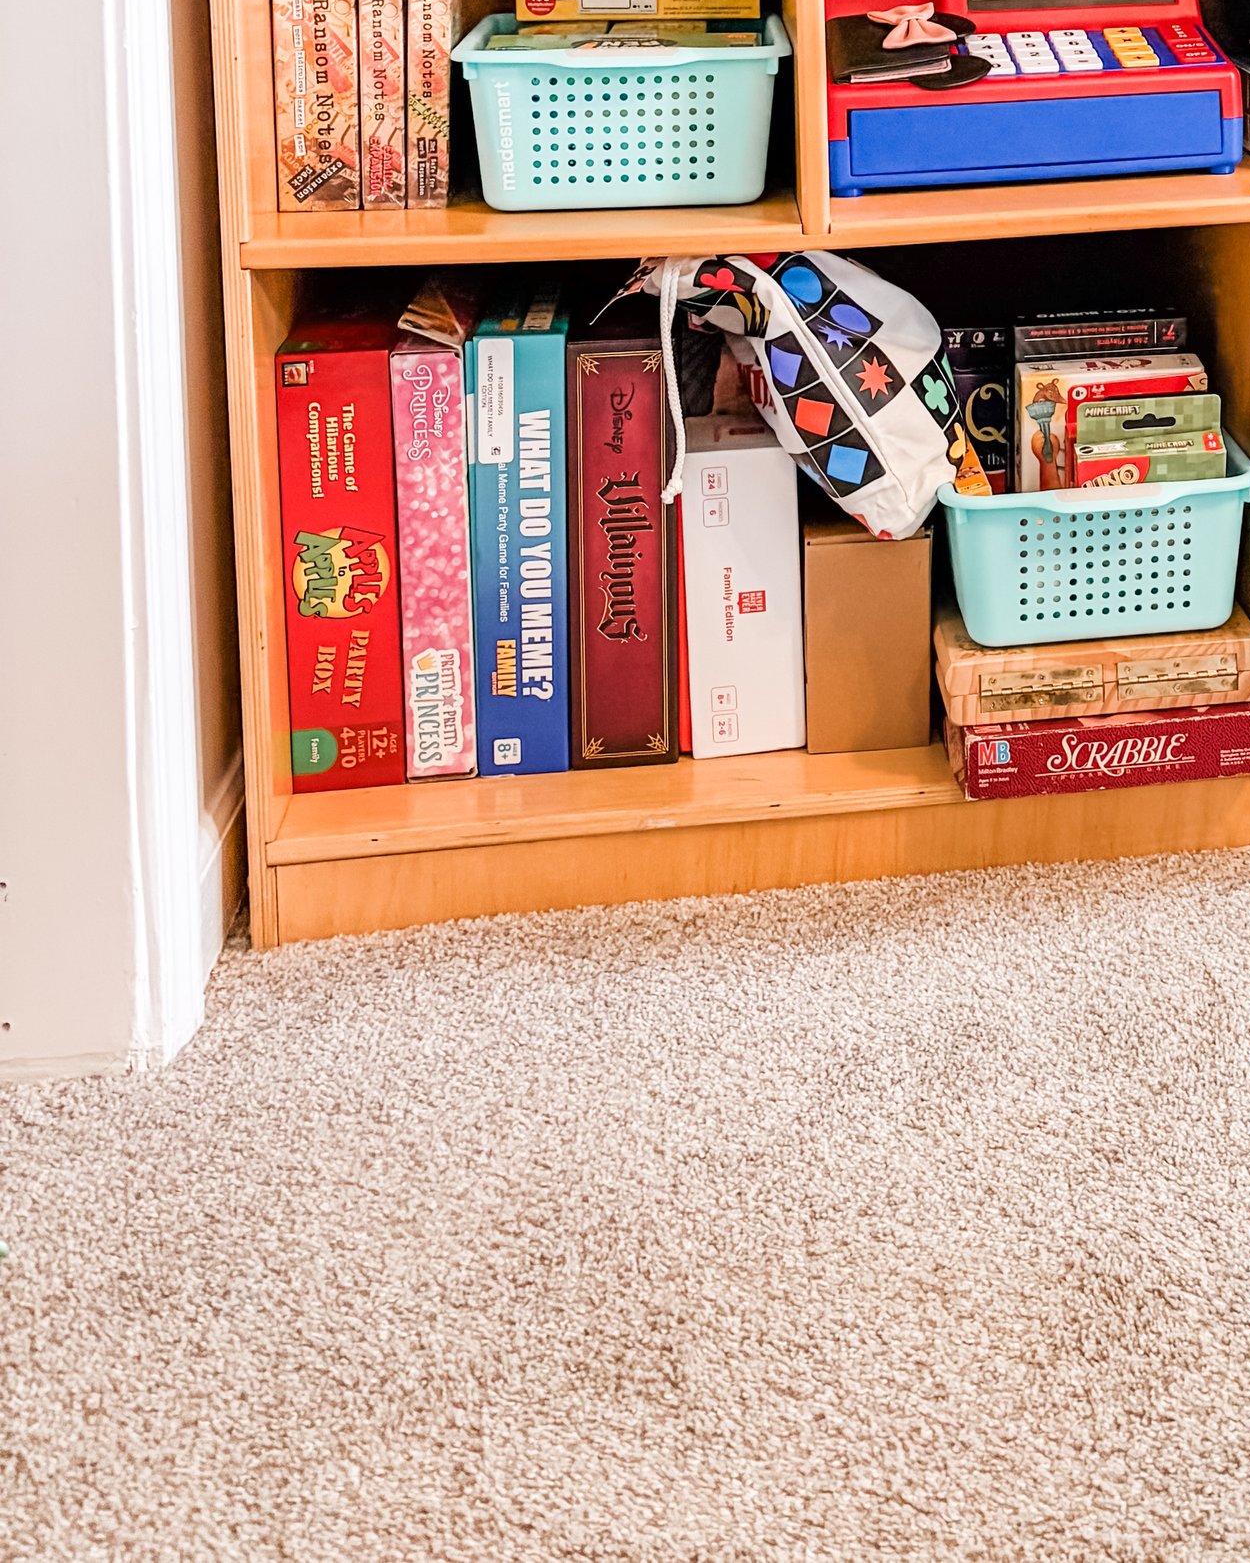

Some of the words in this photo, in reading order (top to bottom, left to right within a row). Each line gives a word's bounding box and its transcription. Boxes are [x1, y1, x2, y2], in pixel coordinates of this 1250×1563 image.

[297, 51, 305, 94] ridiculous
[423, 49, 436, 99] Notes
[374, 68, 387, 122] Notes
[315, 93, 335, 165] Notes
[495, 81, 516, 191] madesmart
[341, 402, 355, 430] The
[402, 365, 432, 460] PRINCESS
[1084, 405, 1140, 417] MINECRAFT
[306, 401, 325, 499] Comparisons!
[325, 416, 340, 481] Hilarious
[343, 432, 356, 474] Game
[518, 409, 551, 492] WHAT
[1146, 440, 1194, 450] MINECRAFT
[345, 476, 359, 492] of
[498, 473, 508, 504] Meme
[707, 473, 715, 490] 224
[1082, 464, 1140, 488] UNO
[496, 506, 509, 532] Party
[519, 498, 552, 537] DO
[498, 534, 509, 565] Game
[596, 470, 654, 644] Villainous
[294, 531, 341, 619] APPLES
[338, 565, 347, 577] to
[339, 526, 386, 614] APPLES
[499, 566, 510, 579] for
[520, 542, 552, 599] YOU
[723, 566, 733, 602] Family
[500, 581, 510, 623] Families
[741, 593, 750, 612] EVER
[724, 604, 736, 642] Edition
[312, 645, 337, 694] BOX
[341, 629, 370, 708] PARTY
[496, 640, 517, 697] FAMILY
[521, 603, 554, 700] MEME?
[440, 653, 456, 691] PRETTY
[340, 726, 357, 768] 4-10
[357, 729, 366, 762] PLAYERS
[372, 726, 387, 759] 12+
[389, 731, 397, 754] AGES
[443, 710, 458, 747] PRETTY
[310, 737, 320, 764] Family
[497, 743, 511, 760] 8+
[978, 740, 1011, 766] MB
[1046, 733, 1187, 776] SCRABBLE
[1147, 764, 1181, 772] GAME
